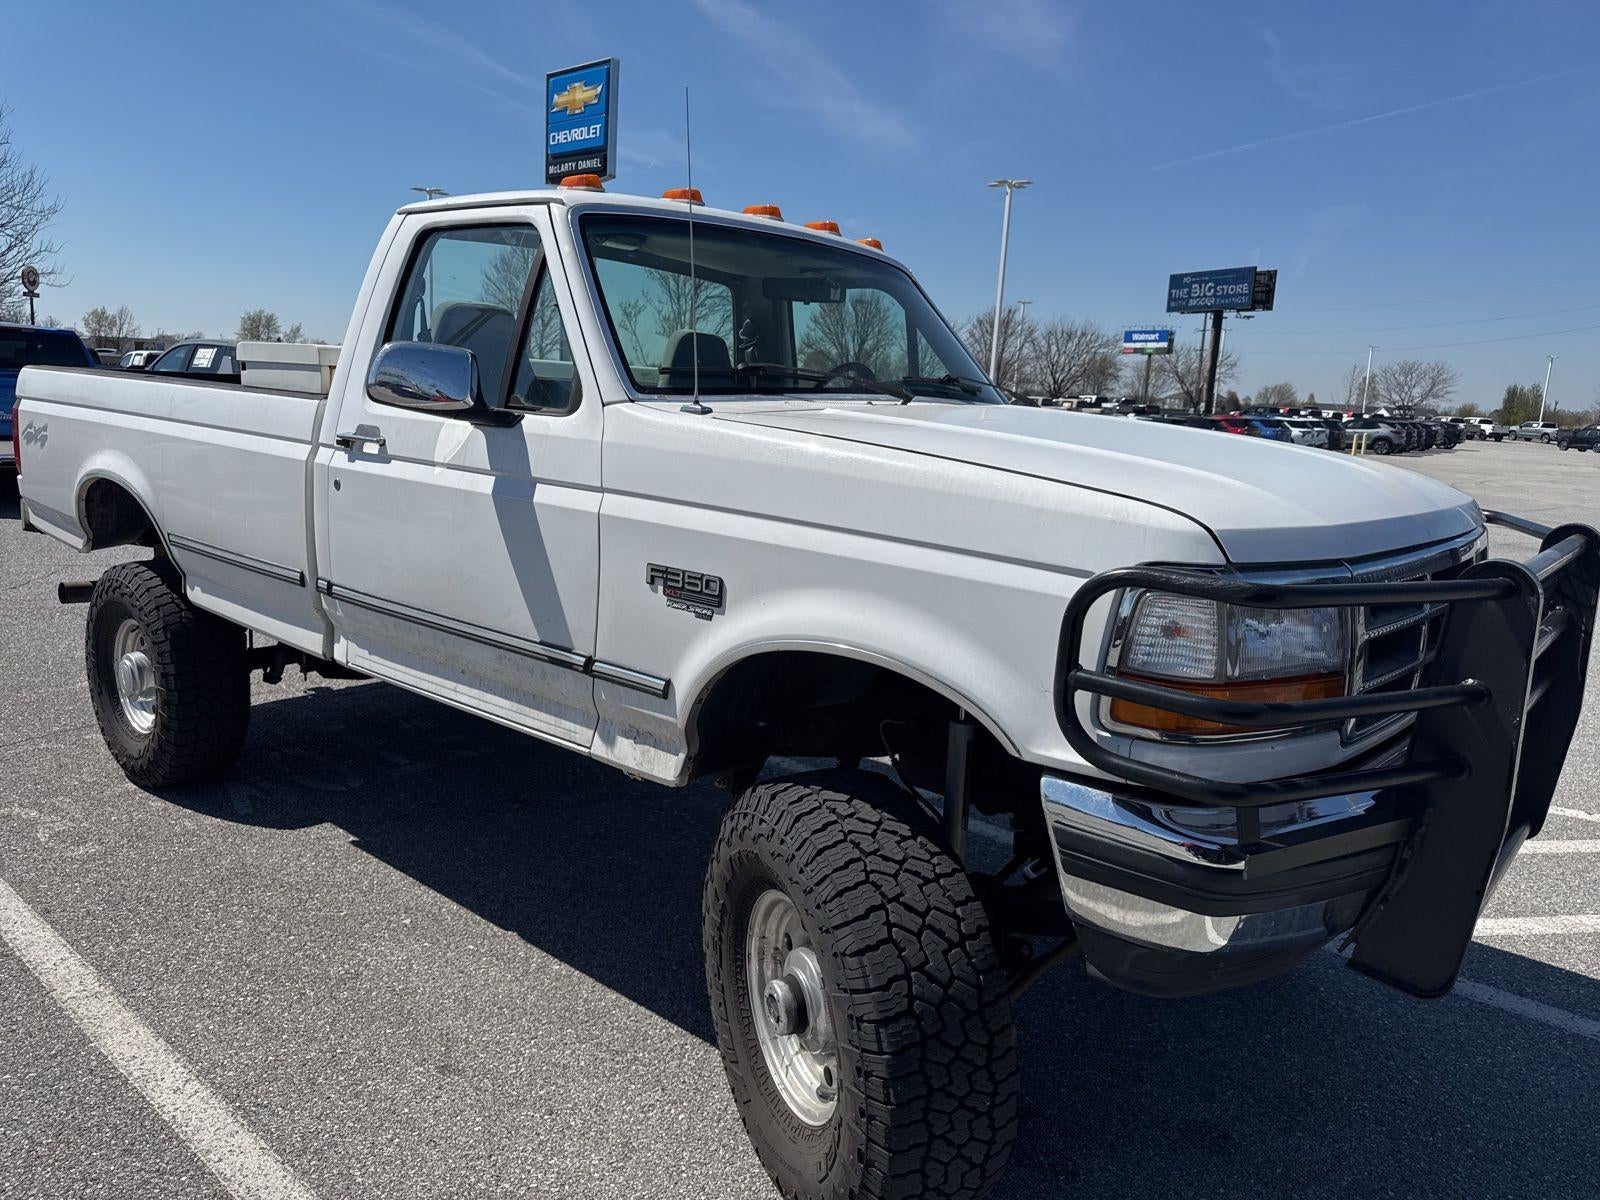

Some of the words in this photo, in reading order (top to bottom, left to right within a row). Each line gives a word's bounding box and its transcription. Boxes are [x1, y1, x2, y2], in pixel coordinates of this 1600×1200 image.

[549, 124, 602, 145] CHEVROLET
[549, 162, 576, 174] McLARTY
[578, 158, 601, 170] DANIEL
[1170, 288, 1189, 298] THE
[1191, 283, 1214, 297] BIG
[1216, 283, 1249, 295] STORE
[1132, 333, 1159, 341] Walmart
[664, 587, 682, 597] XLT
